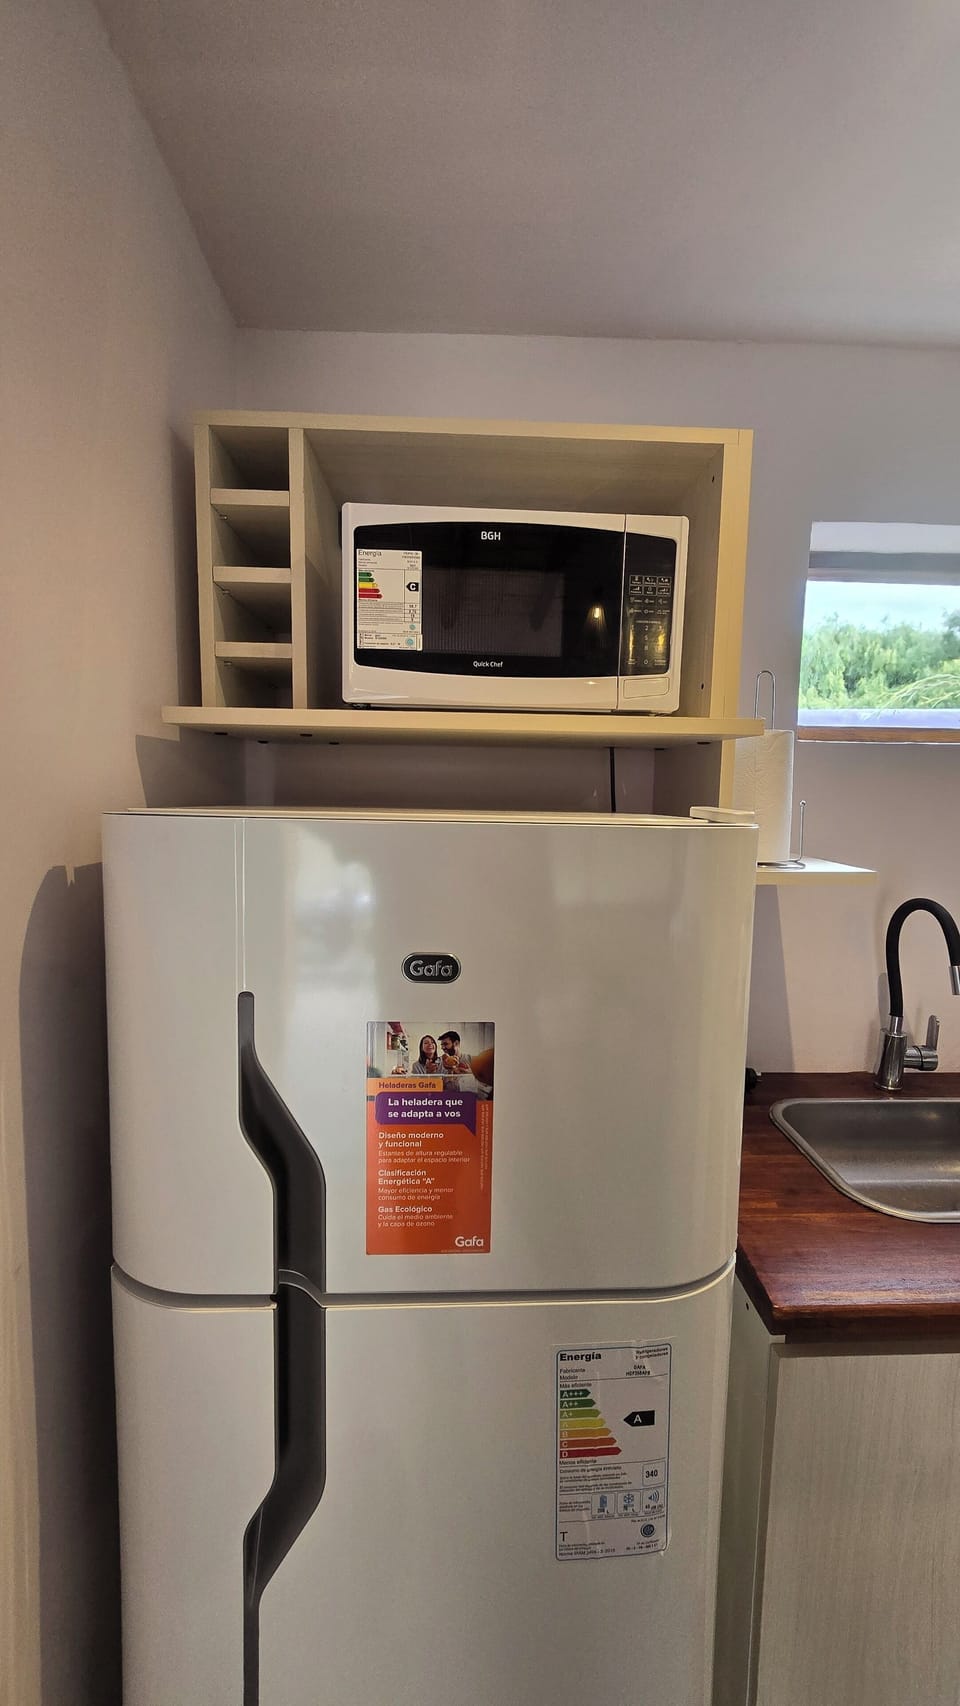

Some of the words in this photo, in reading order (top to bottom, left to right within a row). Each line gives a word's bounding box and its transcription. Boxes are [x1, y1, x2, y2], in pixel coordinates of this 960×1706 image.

[481, 531, 501, 540] BGH
[410, 583, 417, 591] C
[409, 960, 453, 976] Gafa
[378, 1081, 417, 1089] Heladeras
[418, 1081, 436, 1089] Gafa
[388, 1098, 400, 1106] La
[402, 1098, 443, 1106] heladera
[445, 1099, 464, 1108] que
[401, 1109, 435, 1119] adapta
[378, 1131, 406, 1139] Diseño
[378, 1178, 421, 1186] Energética
[395, 1205, 433, 1213] Ecológico
[454, 1236, 484, 1247] Gafa
[559, 1352, 602, 1362] Energía
[633, 1414, 643, 1424] A
[645, 1469, 659, 1479] 340
[559, 1531, 569, 1542] T
